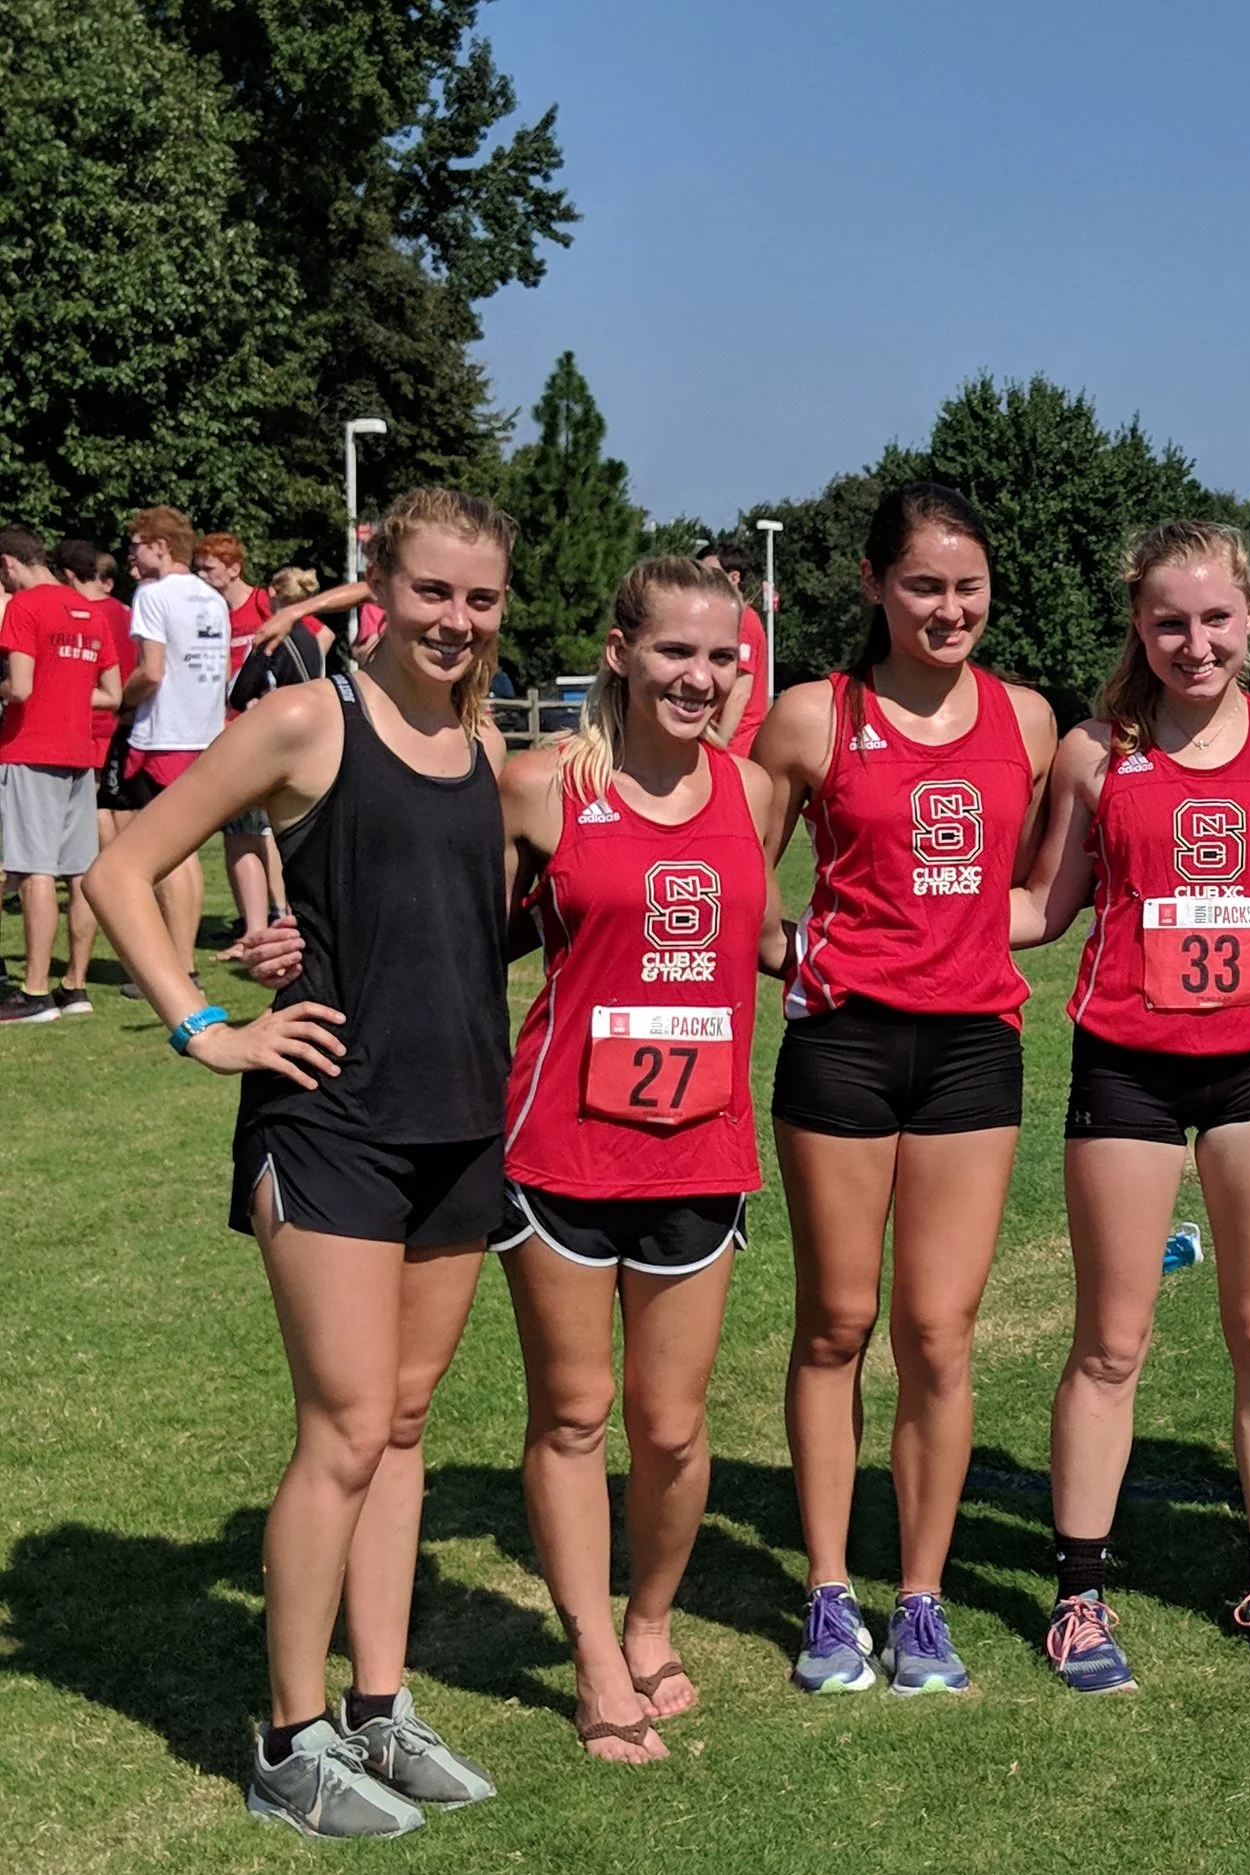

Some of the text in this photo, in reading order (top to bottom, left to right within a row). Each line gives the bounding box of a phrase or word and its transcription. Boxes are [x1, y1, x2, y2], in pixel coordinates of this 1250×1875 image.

[849, 739, 888, 751] adas
[1117, 762, 1154, 775] adidas
[577, 812, 621, 824] adidas
[912, 866, 983, 882] CLUB XC
[929, 880, 981, 896] TRACK
[1174, 885, 1245, 899] CLUB XC
[642, 951, 717, 968] CLUB XC
[1182, 934, 1240, 993] 33
[660, 967, 715, 982] TRACK
[629, 1046, 698, 1109] 27
